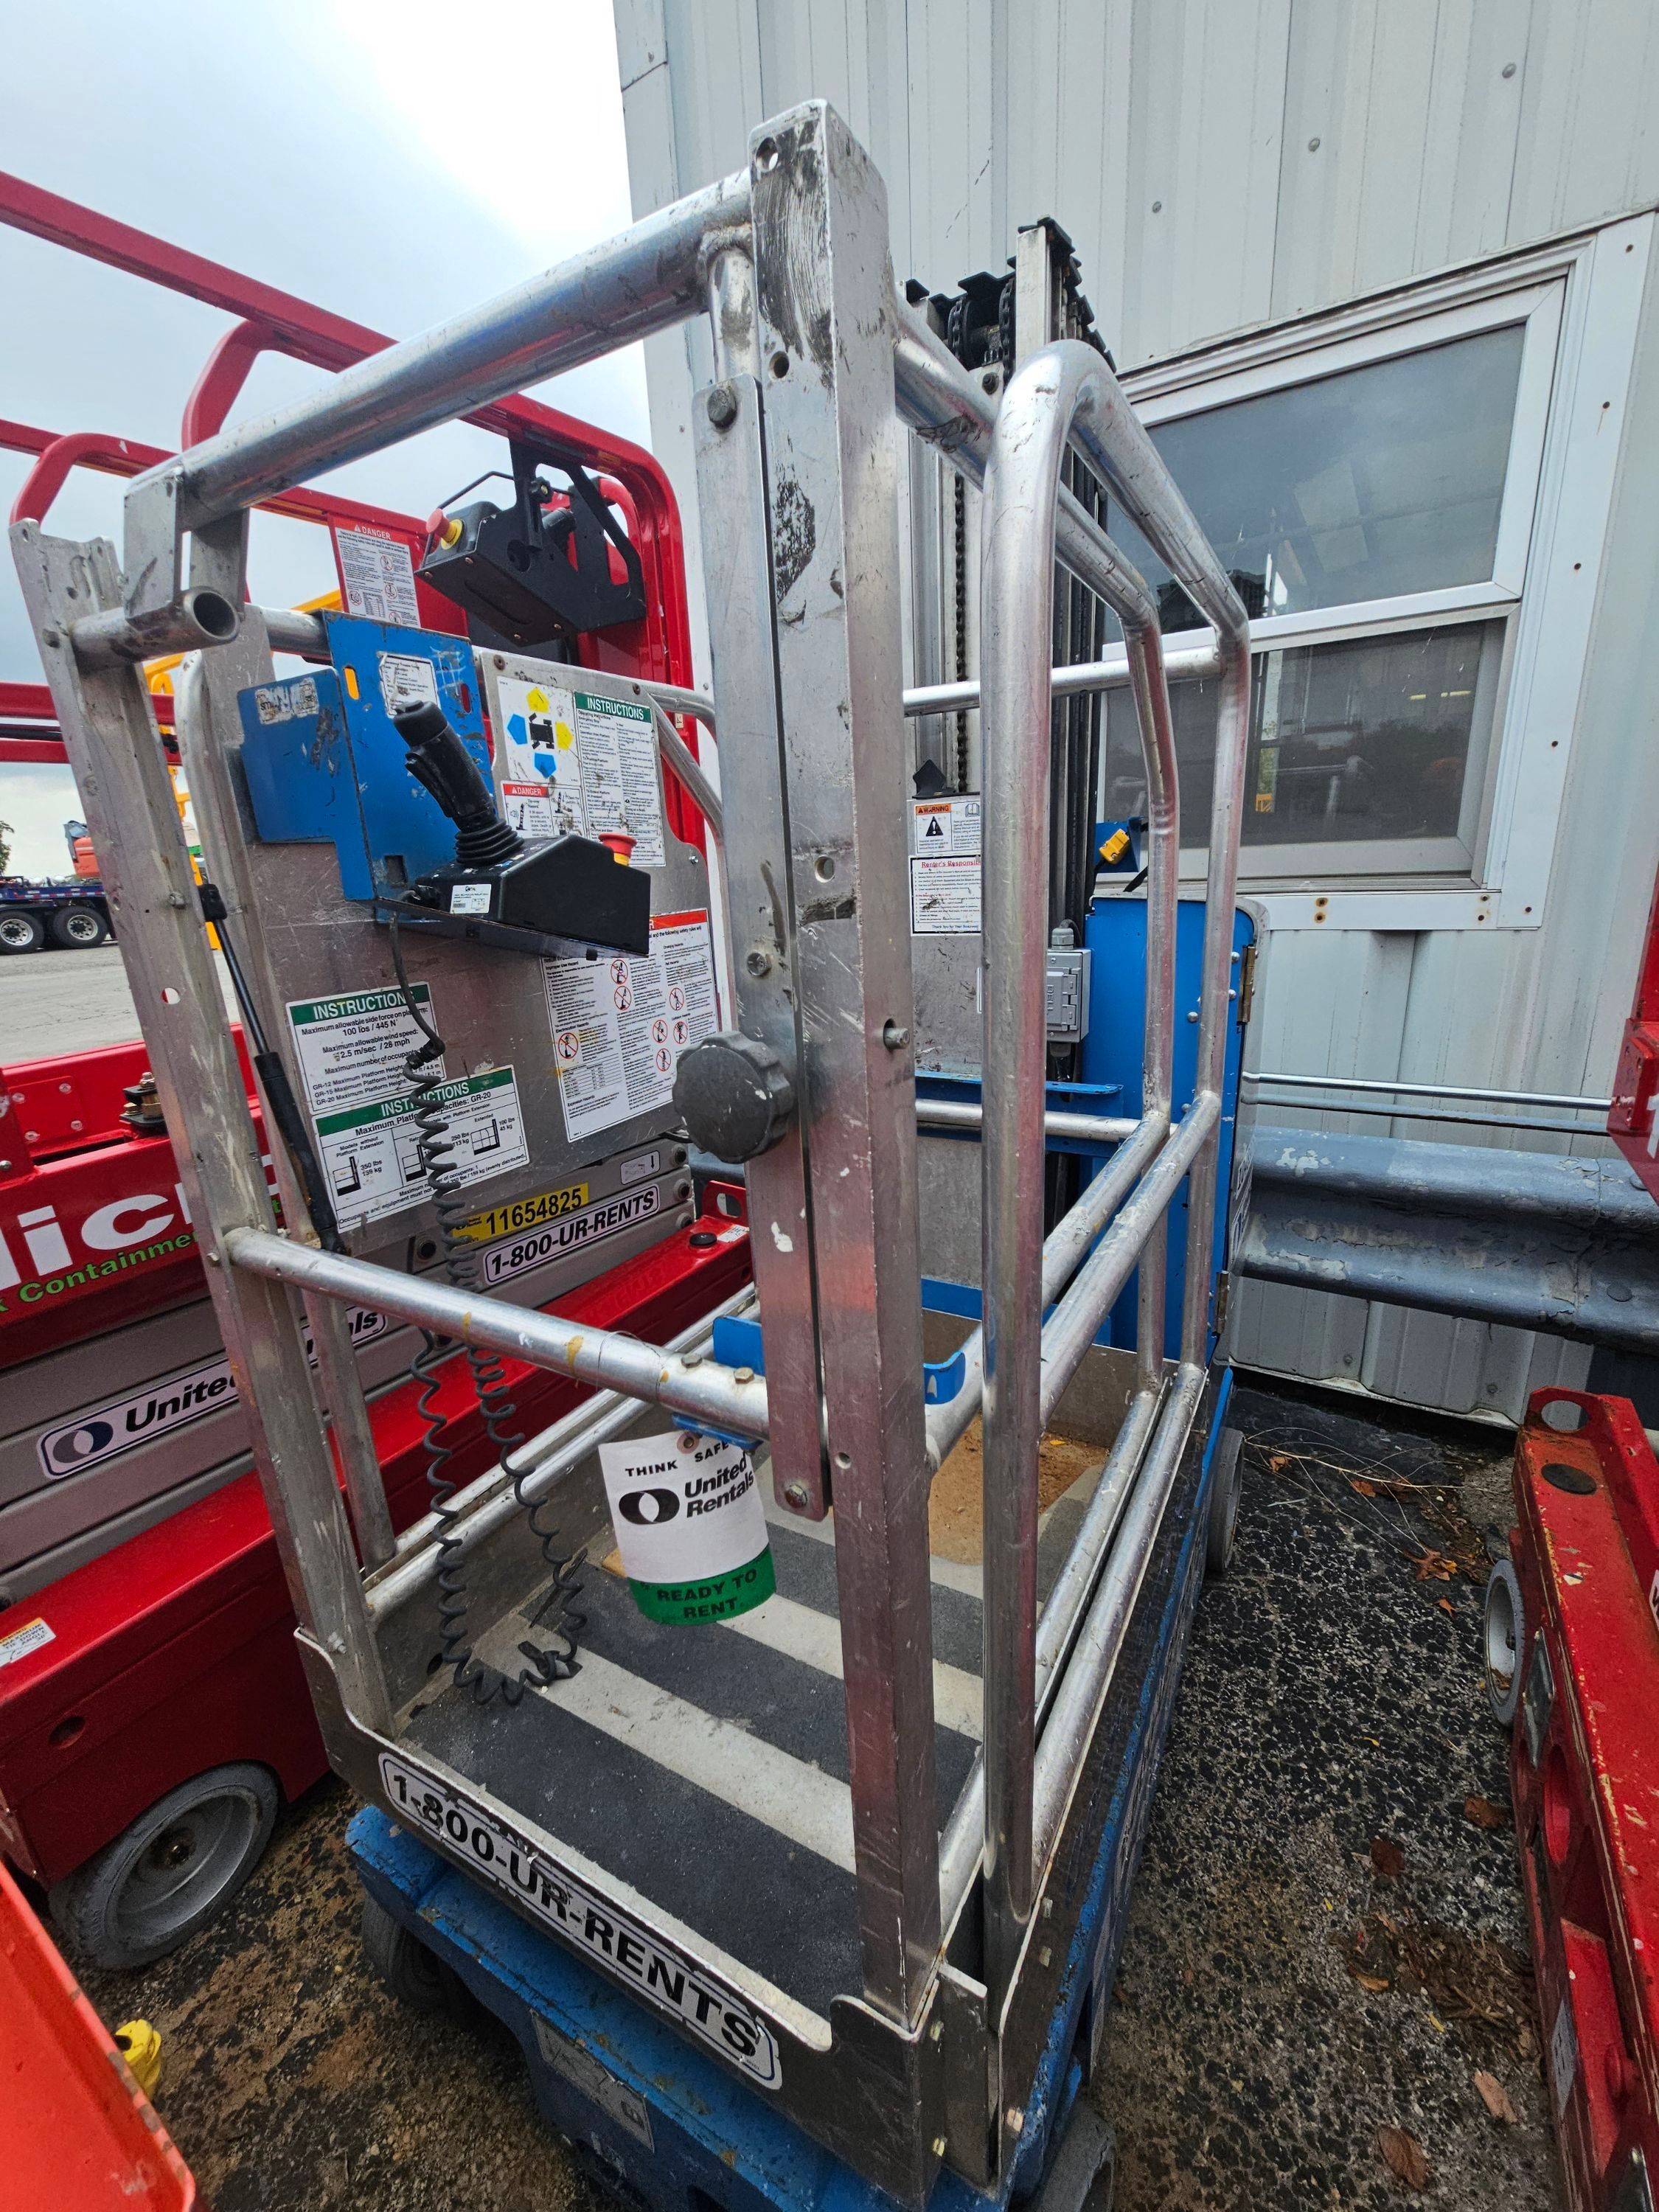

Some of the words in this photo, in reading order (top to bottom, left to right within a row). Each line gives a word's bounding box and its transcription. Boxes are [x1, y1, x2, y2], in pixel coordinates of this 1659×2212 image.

[361, 526, 392, 540] DANGER
[587, 697, 644, 720] INSTRUCTIONS
[516, 787, 542, 796] DANGER
[313, 990, 415, 1020] INSTRUCTION
[302, 1024, 335, 1035] Maximum
[335, 1018, 365, 1029] allowable
[365, 1016, 378, 1024] side
[342, 1026, 357, 1036] 100
[358, 1025, 370, 1033] lbs
[375, 1021, 389, 1029] 445
[322, 1043, 354, 1053] Maximum
[355, 1036, 383, 1047] allowable
[399, 1029, 419, 1037] speed:
[354, 1046, 377, 1055] m/sec
[384, 1040, 393, 1049] 28
[394, 1038, 411, 1047] mph
[324, 1063, 356, 1074] Maximum
[356, 1058, 380, 1068] number
[313, 1082, 332, 1090] GR-12
[333, 1075, 361, 1085] Maximum
[361, 1069, 385, 1079] Platform
[314, 1089, 333, 1098] GR-15
[334, 1082, 362, 1093] Maximum
[363, 1076, 387, 1085] Platform
[316, 1096, 335, 1105] GR-20
[335, 1090, 364, 1100] Maximum
[365, 1083, 389, 1093] Platform
[389, 1079, 408, 1088] Height:
[355, 1120, 394, 1136] Maximum
[470, 1091, 491, 1102] GR-20
[453, 1109, 470, 1117] Platform
[471, 1103, 491, 1111] Extension
[474, 1113, 493, 1122] Extended
[336, 1148, 358, 1158] Platform
[360, 1140, 384, 1150] Extension
[340, 1142, 358, 1151] Models
[360, 1136, 378, 1144] without
[360, 1162, 372, 1170] 350
[370, 1205, 380, 1214] and
[382, 1195, 410, 1211] equipment
[485, 1162, 501, 1172] (evenly
[399, 1185, 423, 1197] Maximum
[486, 1187, 582, 1235] 11654825
[492, 1191, 654, 1276] 1-800-UR-RENTS
[625, 1459, 678, 1477] THINK
[684, 1452, 747, 1498] United
[686, 1470, 754, 1518] Rentals
[657, 1580, 726, 1601] READY
[731, 1568, 757, 1589] TO
[684, 1597, 737, 1619] RENT
[393, 1773, 758, 2056] 1-800-UR-RENTS
